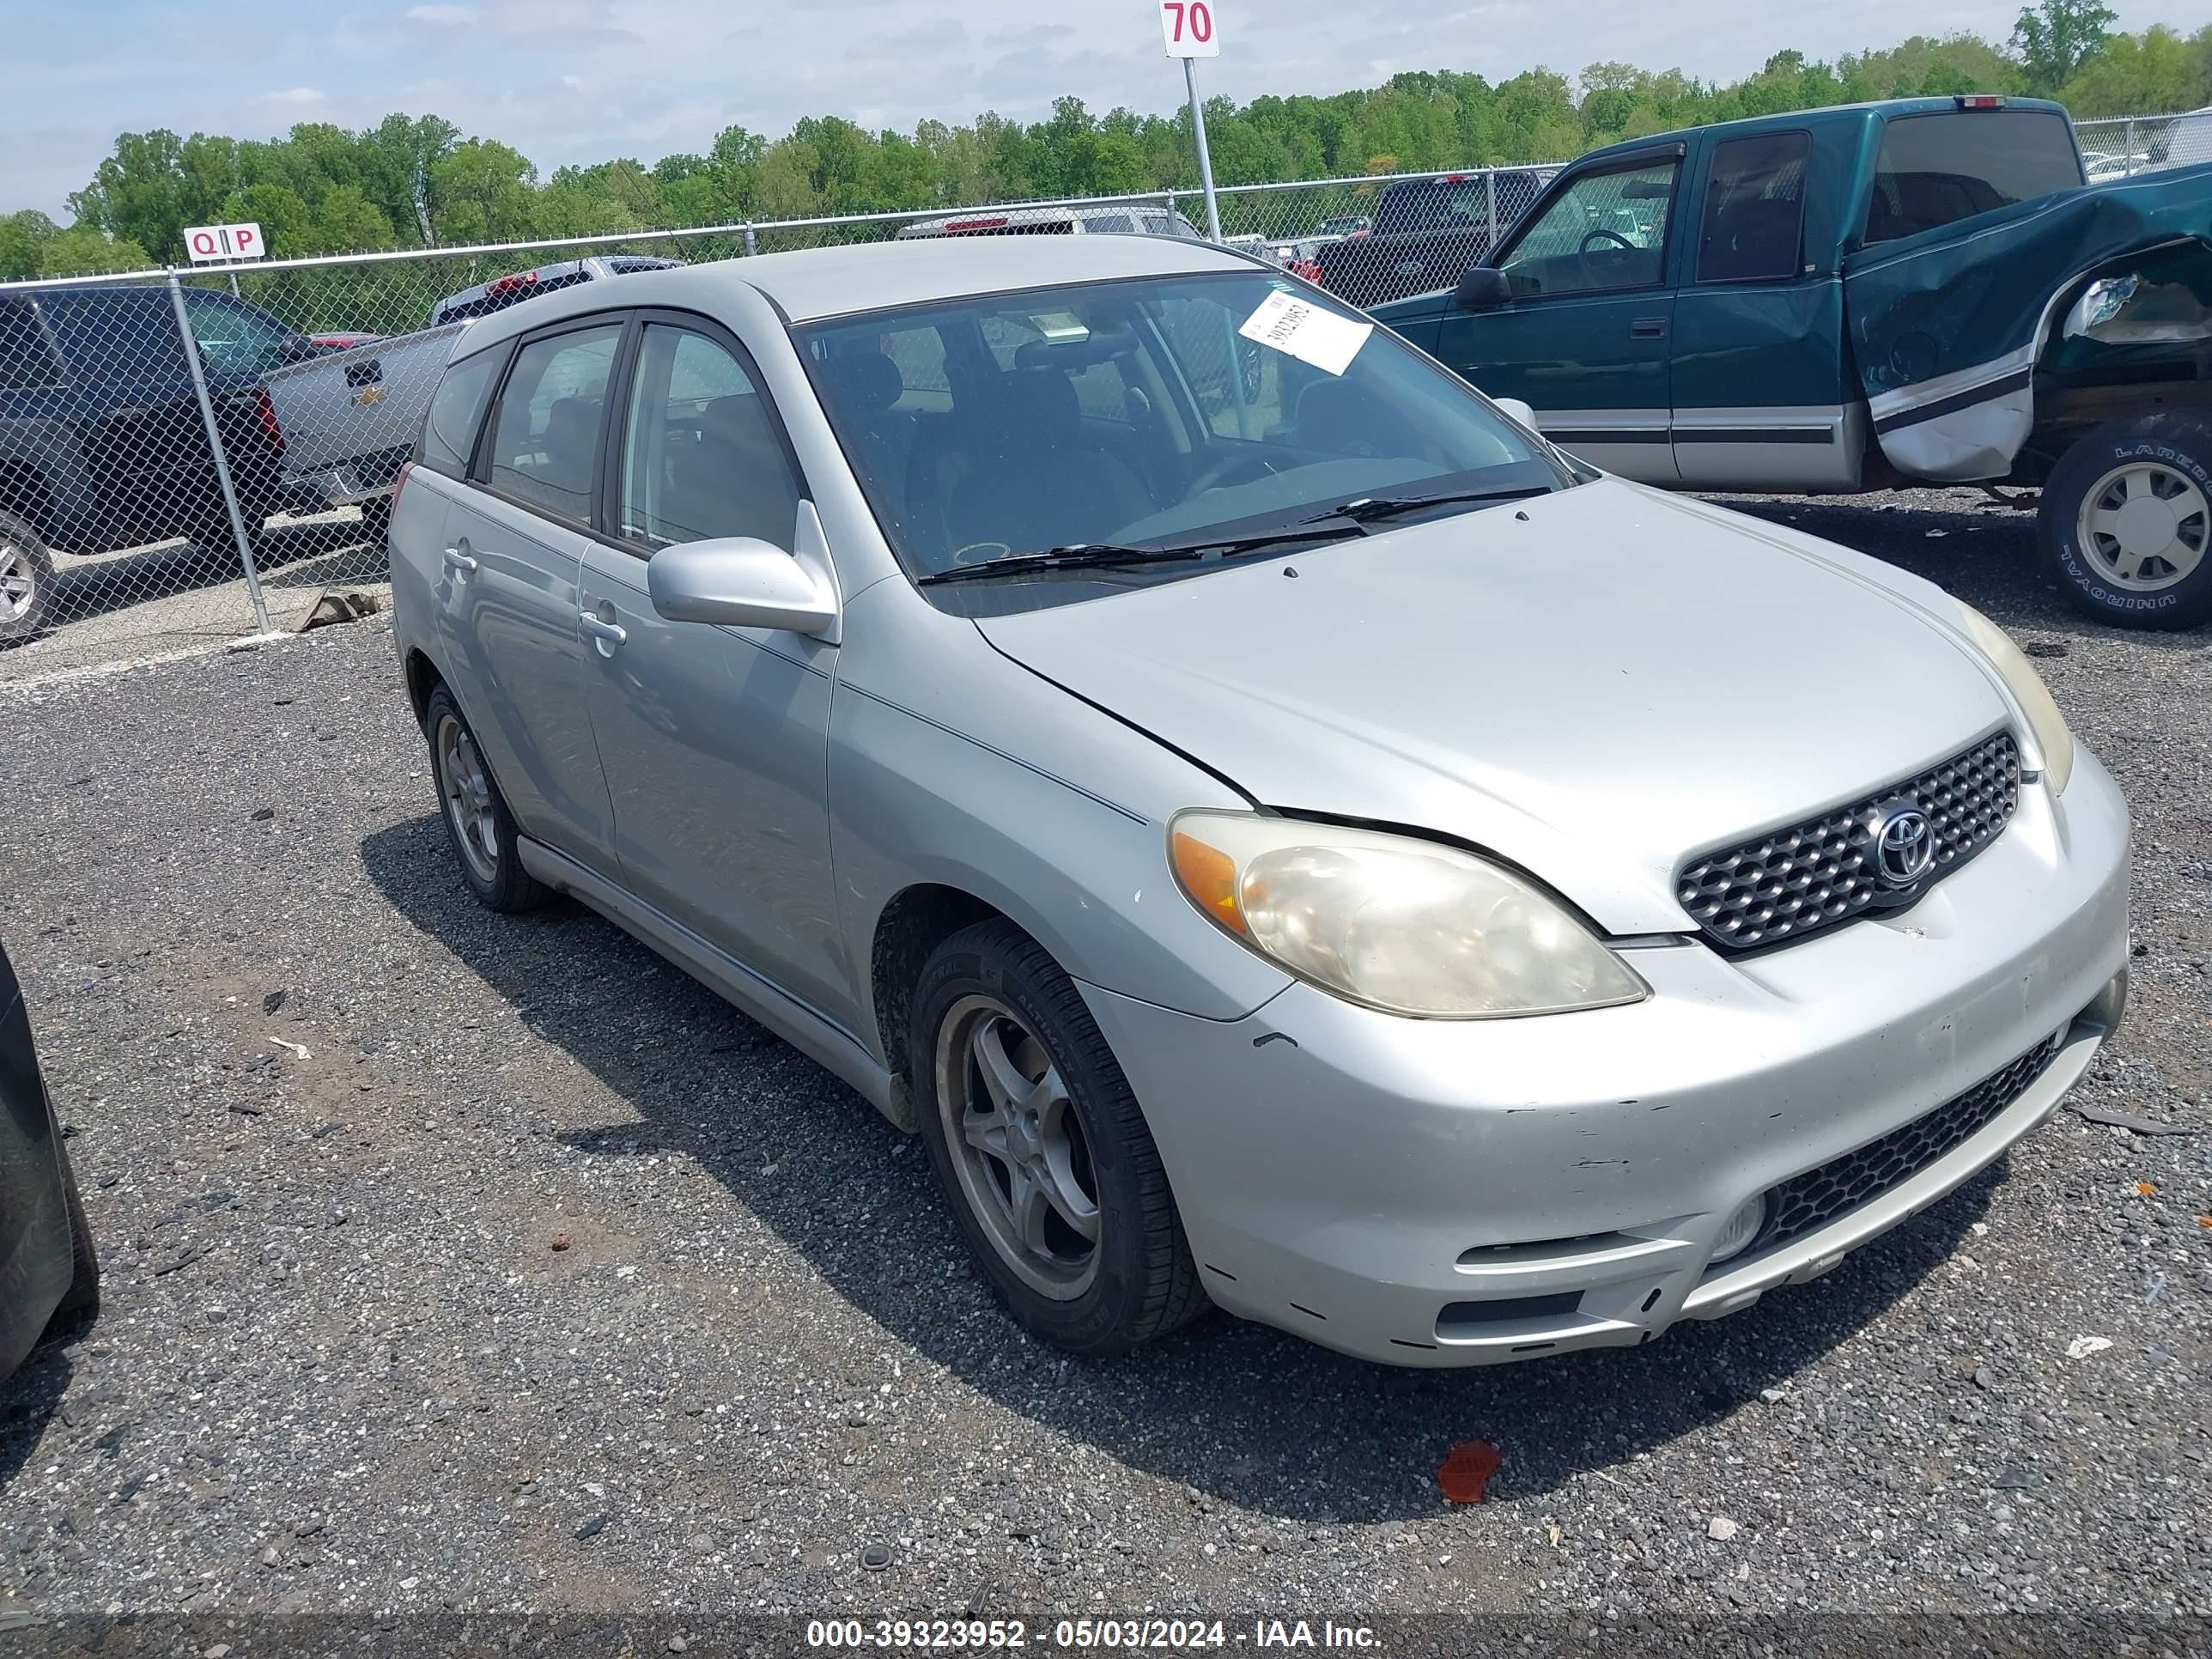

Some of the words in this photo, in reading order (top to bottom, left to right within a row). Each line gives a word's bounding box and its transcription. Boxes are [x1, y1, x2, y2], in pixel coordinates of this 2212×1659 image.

[1164, 2, 1212, 43] 70
[193, 233, 218, 255] Q
[235, 230, 253, 252] P
[1267, 304, 1311, 345] 39323952
[2061, 544, 2177, 610] UNIROYAL
